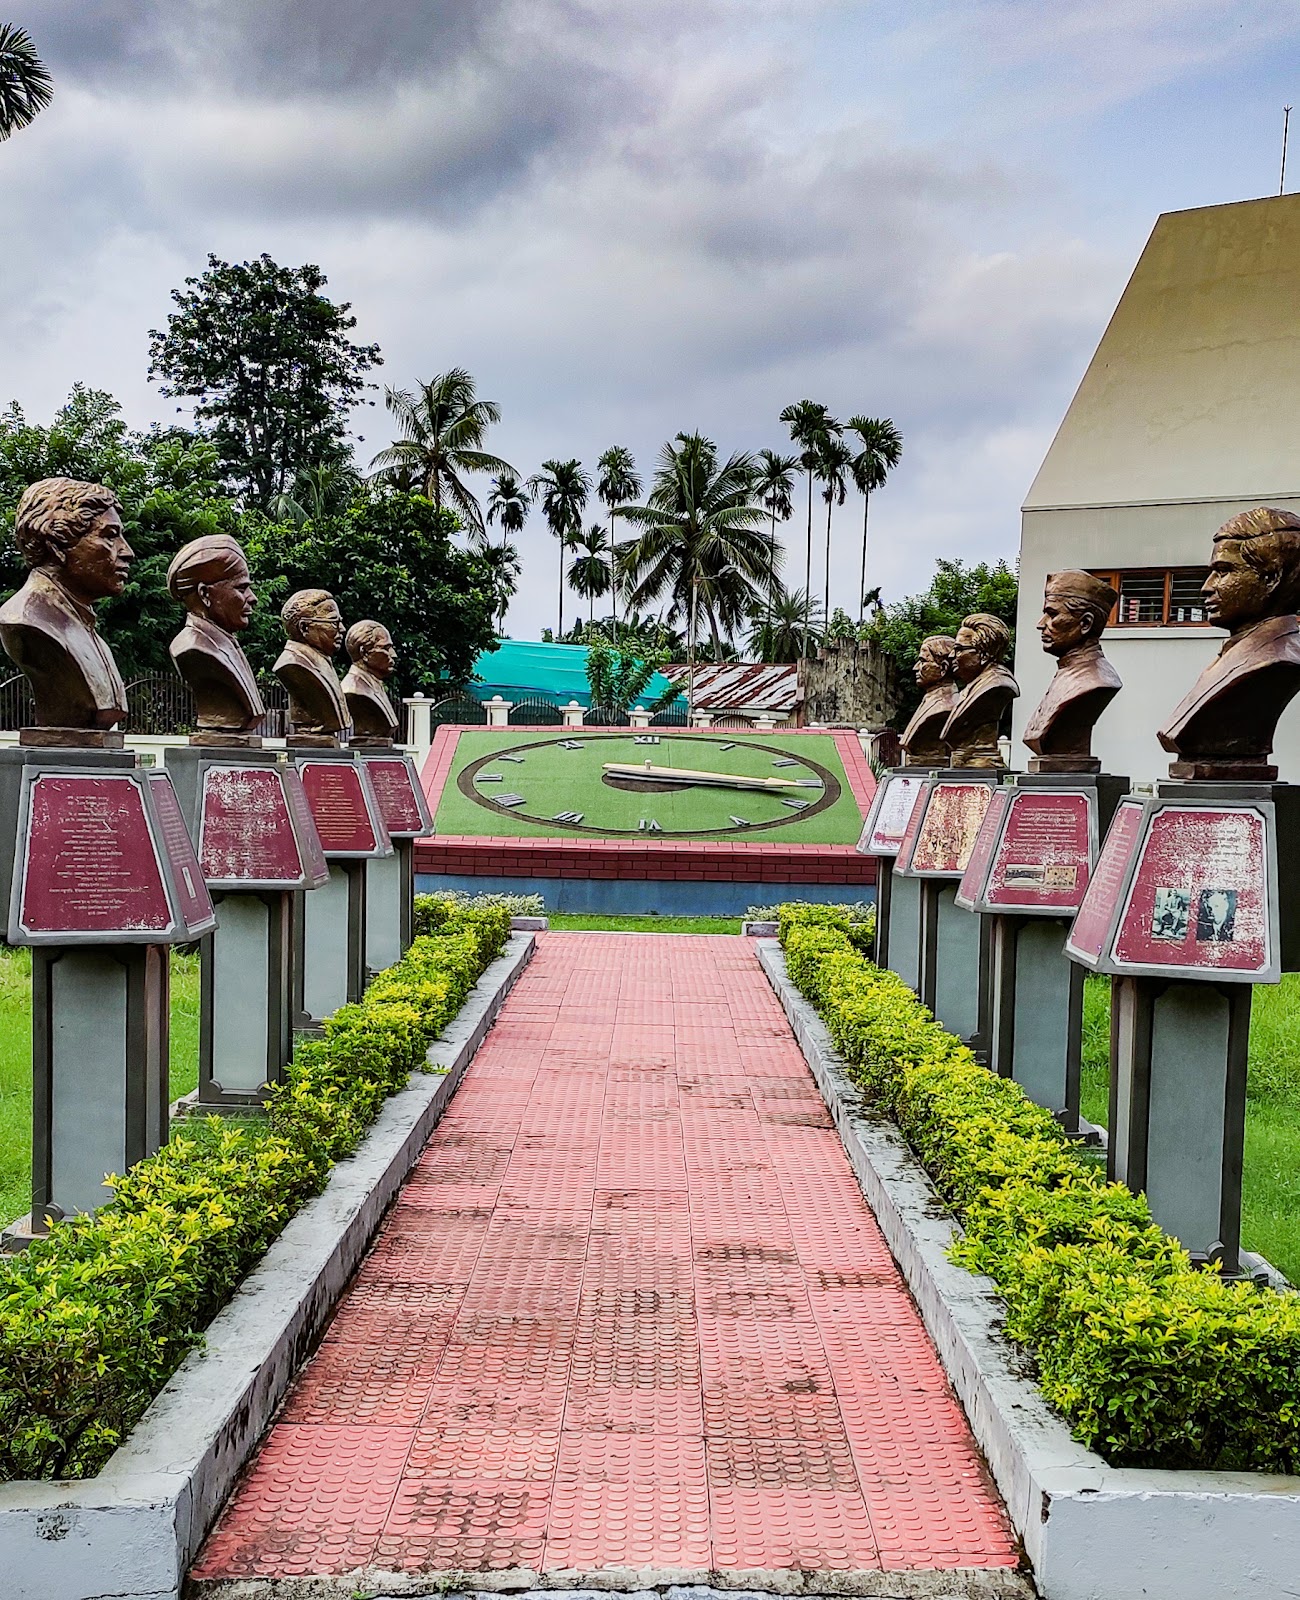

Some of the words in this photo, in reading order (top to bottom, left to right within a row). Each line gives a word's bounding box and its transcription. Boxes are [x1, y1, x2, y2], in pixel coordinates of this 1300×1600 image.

[557, 740, 584, 750] XI
[634, 736, 660, 744] XII
[551, 811, 585, 823] VII
[638, 819, 662, 831] VI
